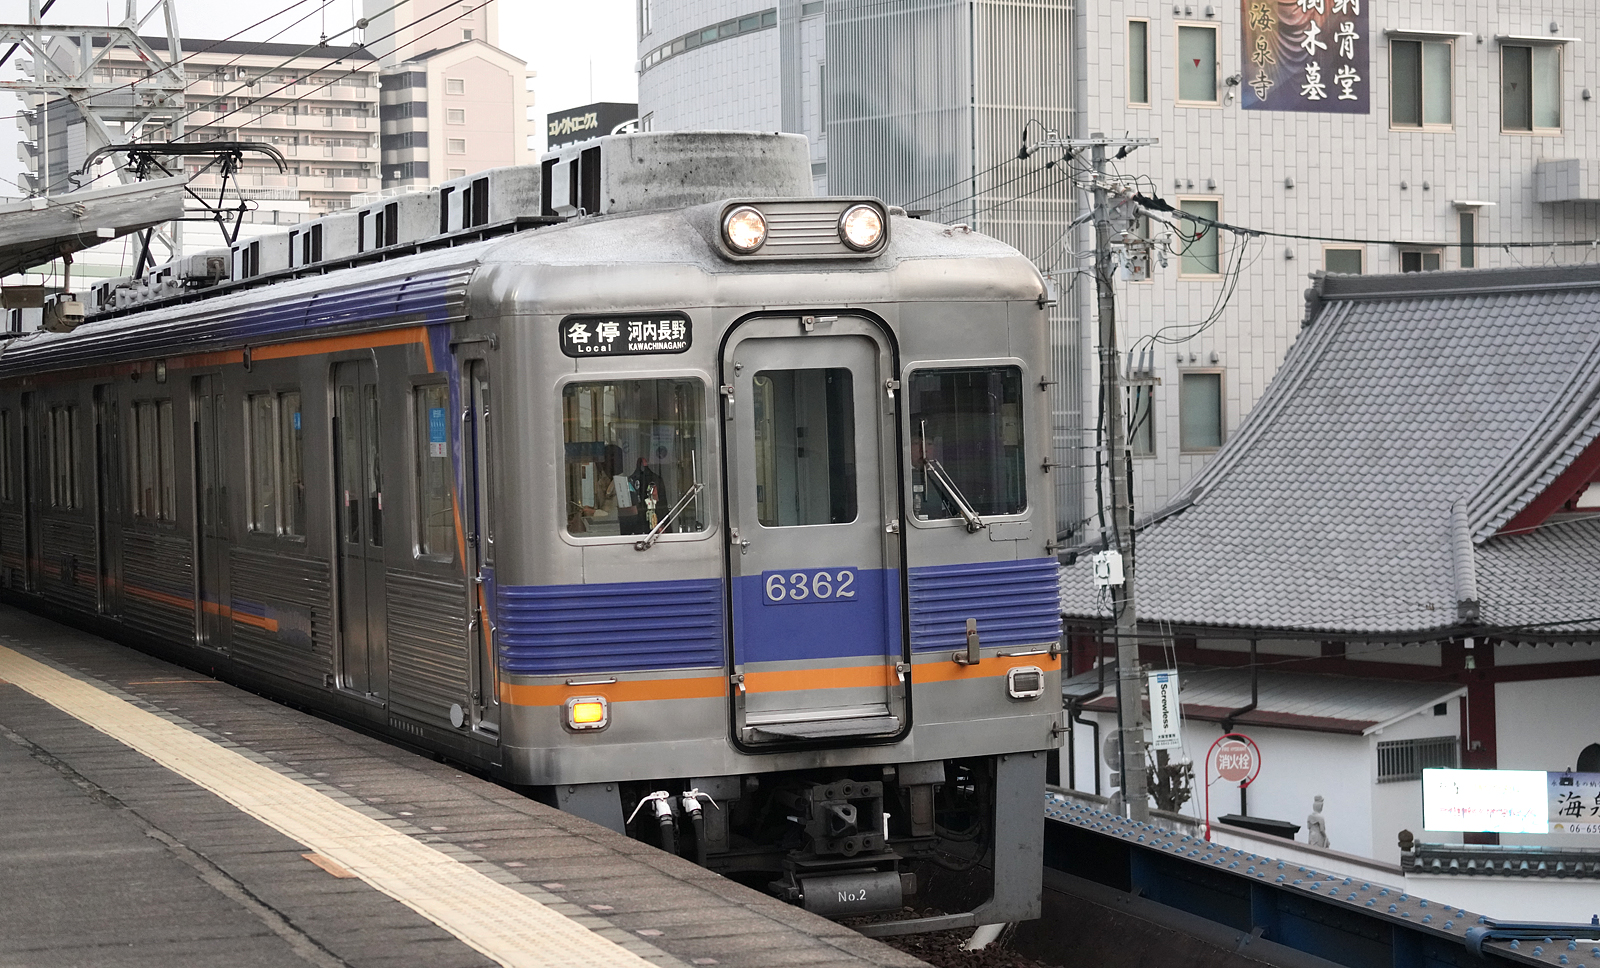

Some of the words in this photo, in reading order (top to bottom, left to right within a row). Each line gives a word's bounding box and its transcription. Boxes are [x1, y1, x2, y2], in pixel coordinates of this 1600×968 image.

[1248, 3, 1276, 101] 海泉寺
[549, 112, 598, 136] エレクトロニクス
[567, 322, 620, 344] 各停
[628, 320, 686, 341] 河内長野
[577, 344, 612, 352] Local
[766, 570, 855, 602] 6362
[1160, 683, 1169, 729] Screwless
[1219, 753, 1250, 770] 消火栓
[838, 889, 866, 902] No.2
